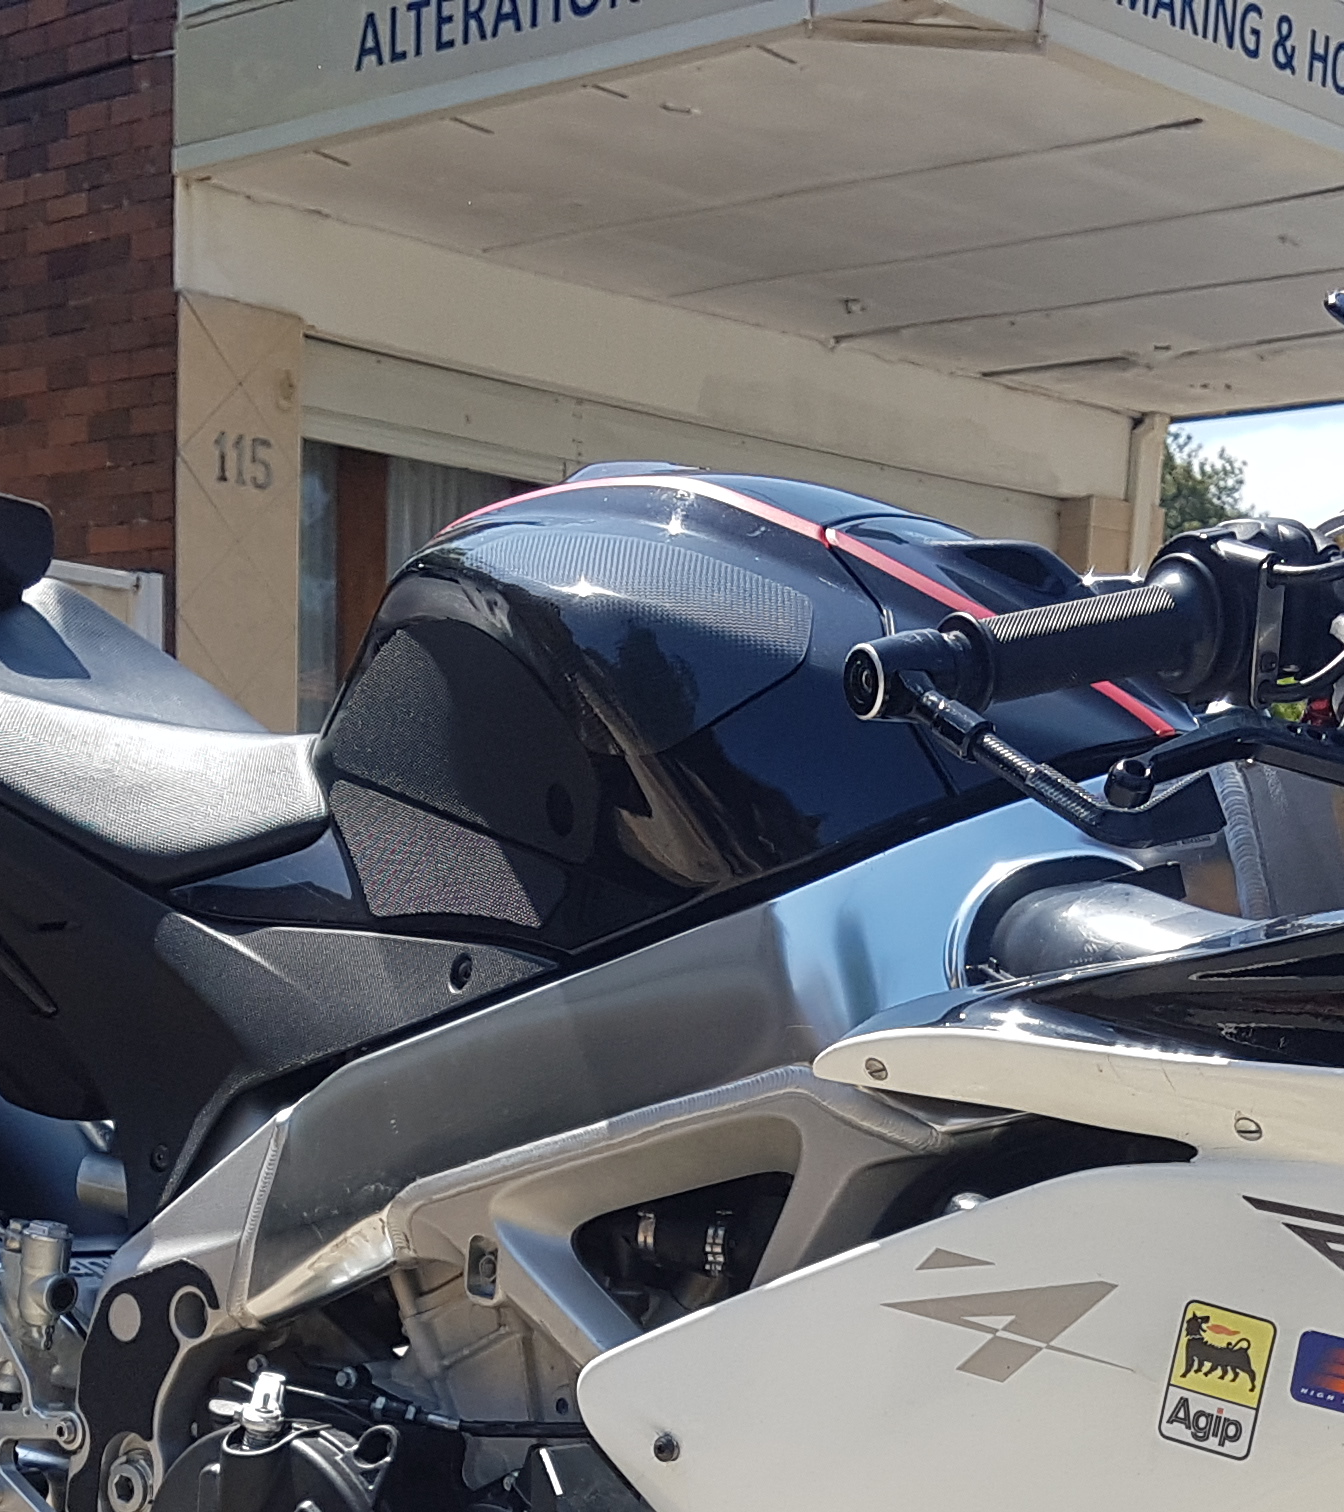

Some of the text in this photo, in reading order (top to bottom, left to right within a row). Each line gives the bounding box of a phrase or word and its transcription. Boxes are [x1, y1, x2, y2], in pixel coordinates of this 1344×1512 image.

[355, 0, 641, 71] ALTERA
[1272, 14, 1296, 76] &
[214, 430, 273, 491] 115
[1166, 1396, 1242, 1447] Agip
[1300, 1387, 1335, 1401] HIGH
